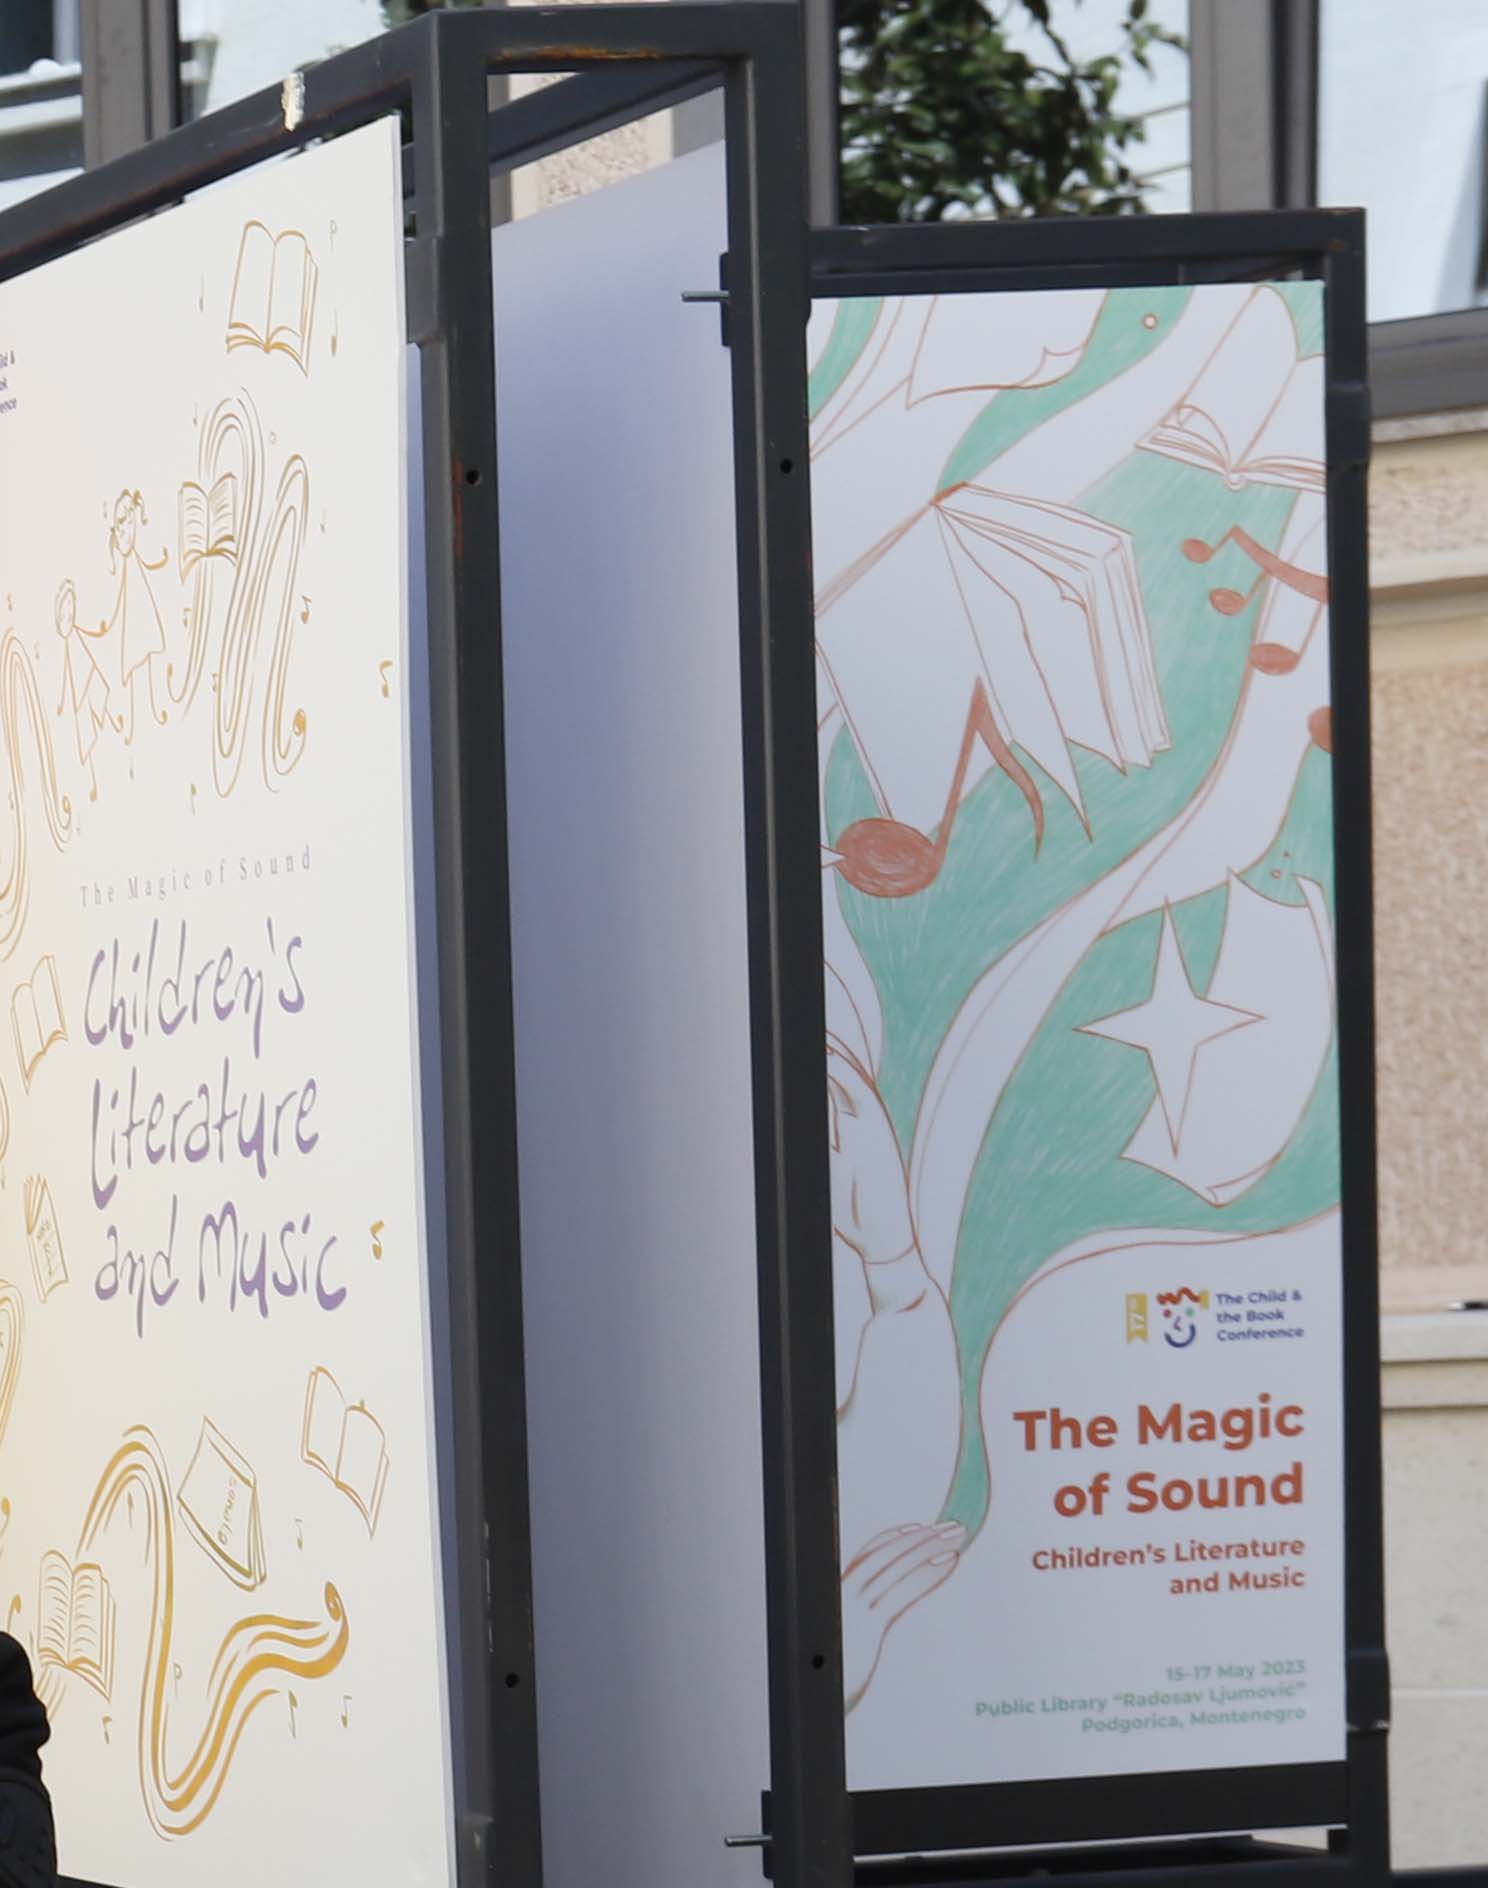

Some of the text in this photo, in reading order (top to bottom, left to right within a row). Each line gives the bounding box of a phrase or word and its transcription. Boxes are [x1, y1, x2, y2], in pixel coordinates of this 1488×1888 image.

[81, 845, 312, 907] The Magic of Sound
[84, 917, 305, 1059] Children's
[90, 1056, 319, 1210] Literature
[95, 1194, 180, 1339] and
[198, 1200, 347, 1318] Music
[1215, 1291, 1242, 1306] The
[1247, 1288, 1287, 1305] Child
[1217, 1307, 1285, 1324] the Book
[1217, 1325, 1304, 1342] Conference
[1013, 1392, 1304, 1453] The Magic
[1053, 1461, 1304, 1517] of Sound
[1032, 1536, 1305, 1571] Children's Literature
[1169, 1569, 1305, 1596] and Music
[1217, 1663, 1255, 1681] May
[1262, 1659, 1305, 1676] 2023
[976, 1699, 1034, 1718] Public
[1041, 1694, 1107, 1714] Library
[1082, 1706, 1306, 1734] Podgorica, Montenegro
